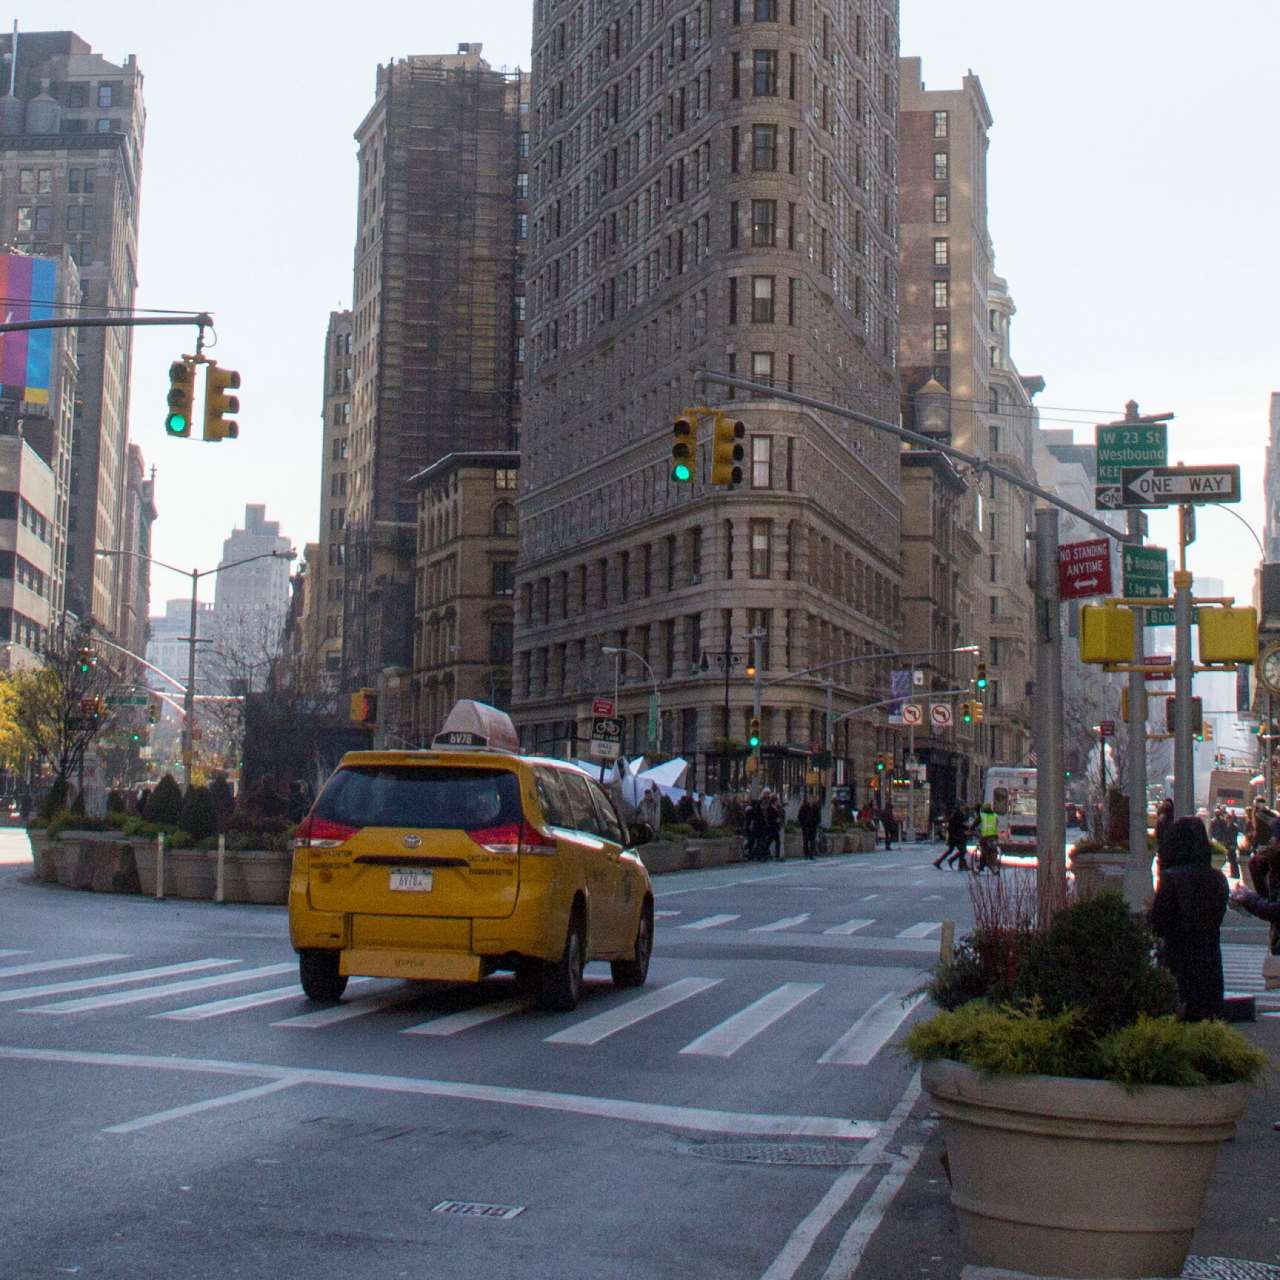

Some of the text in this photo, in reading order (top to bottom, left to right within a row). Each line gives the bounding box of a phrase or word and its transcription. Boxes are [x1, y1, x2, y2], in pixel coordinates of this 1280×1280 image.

[1103, 431, 1160, 444] W 23 St
[1099, 448, 1165, 461] Westbound
[1140, 476, 1223, 493] ONE WAY
[1060, 543, 1107, 561] NO STANDING
[1066, 560, 1103, 577] ANYTIME
